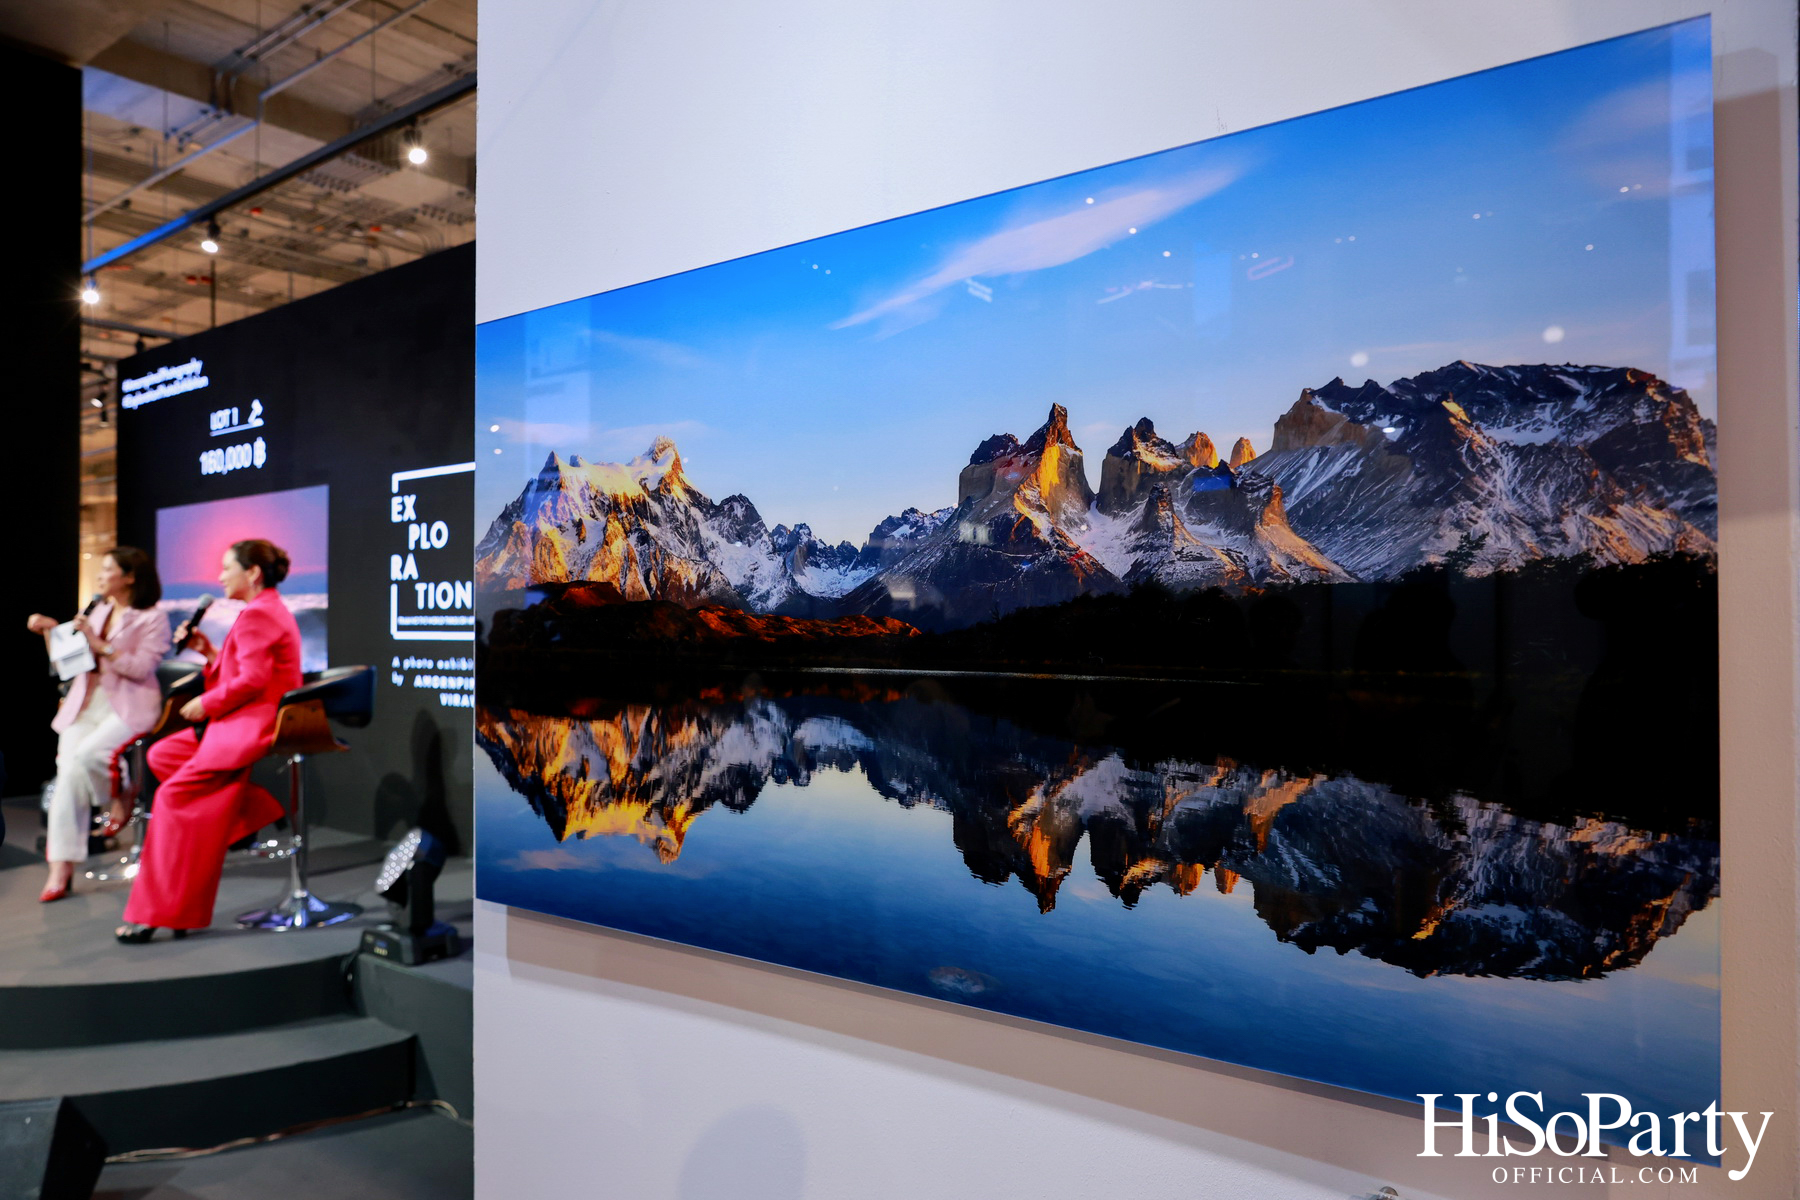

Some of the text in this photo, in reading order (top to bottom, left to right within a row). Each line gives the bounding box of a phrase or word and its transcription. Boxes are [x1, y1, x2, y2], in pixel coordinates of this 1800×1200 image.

[210, 408, 231, 431] LOT
[391, 494, 416, 523] EX
[408, 520, 449, 550] PLO
[390, 553, 419, 581] RA
[415, 580, 473, 610] TION
[392, 656, 400, 668] A
[403, 656, 434, 670] photo
[392, 671, 404, 687] by
